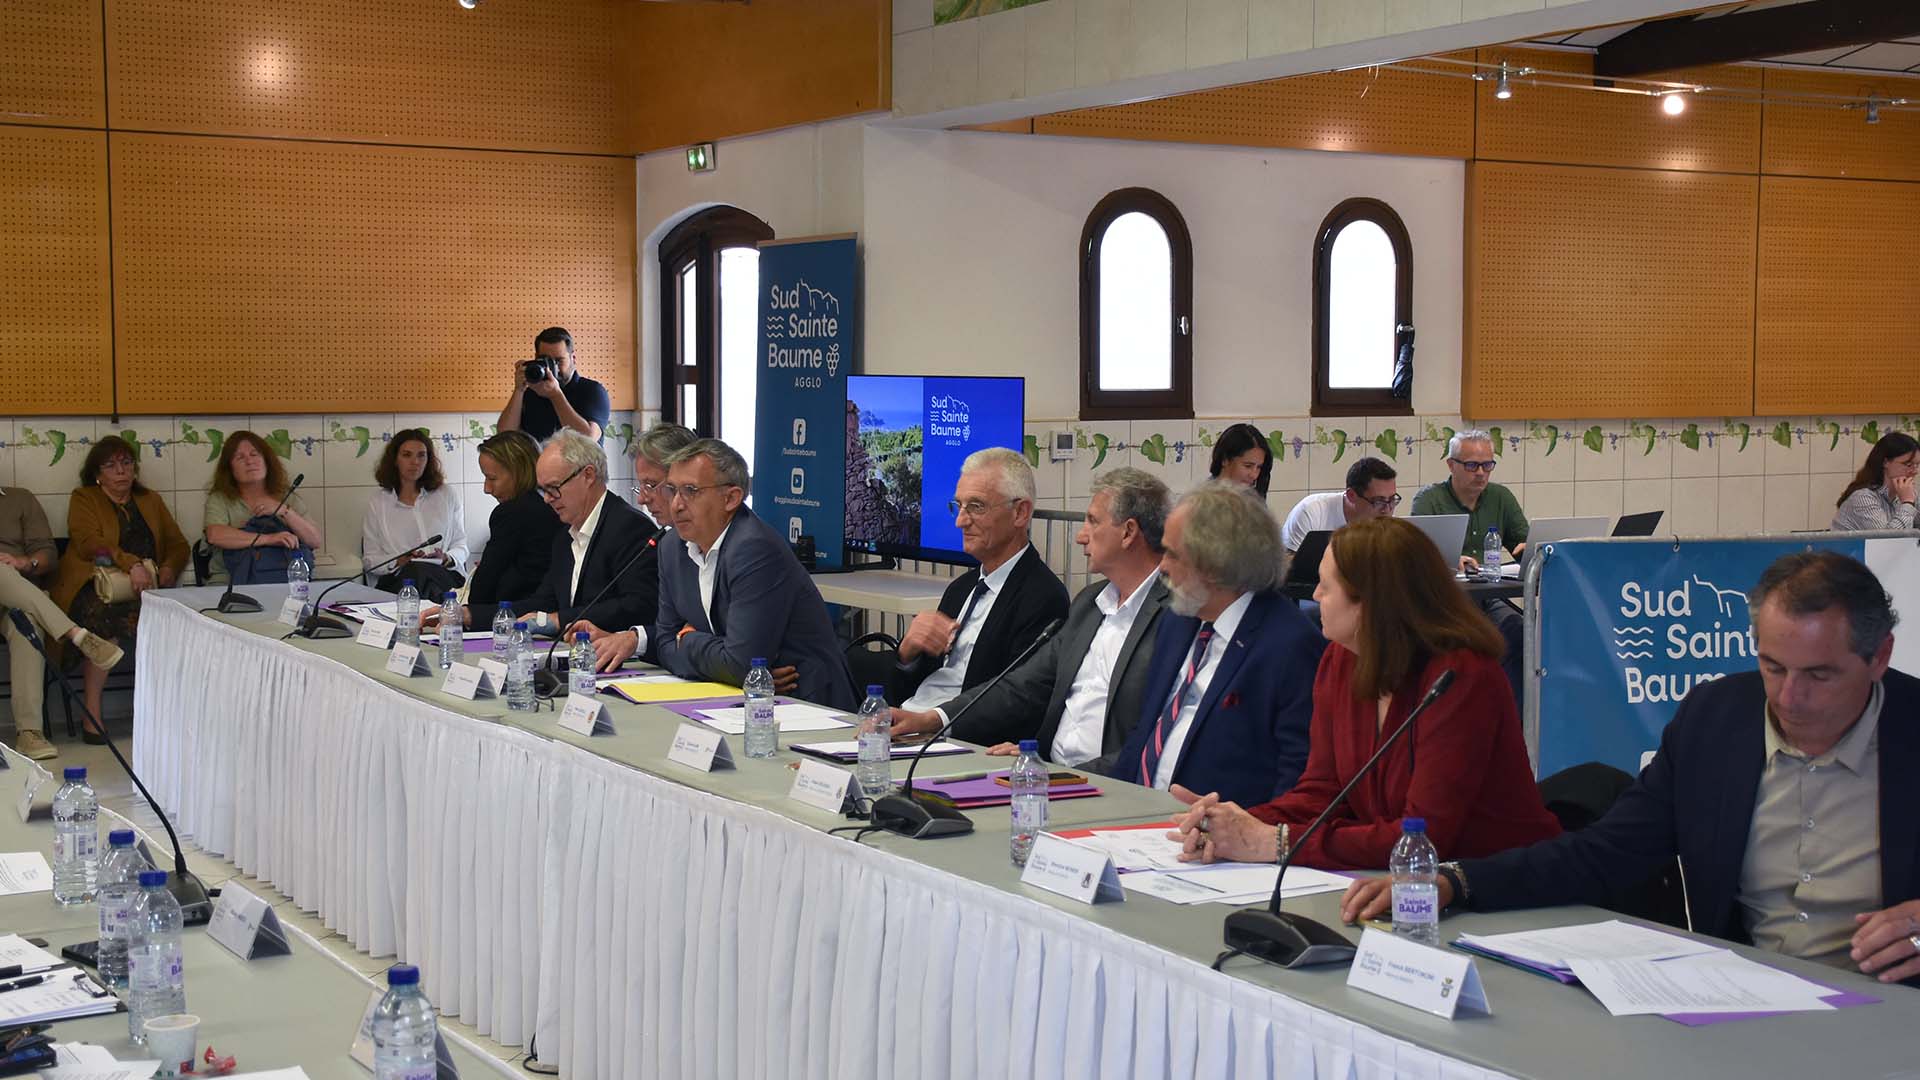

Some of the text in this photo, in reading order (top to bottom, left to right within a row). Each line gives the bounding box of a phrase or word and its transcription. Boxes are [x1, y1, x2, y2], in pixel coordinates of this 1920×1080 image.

[770, 282, 800, 309] Sud
[788, 311, 838, 338] Sainte
[768, 343, 823, 368] Baume
[794, 376, 822, 389] AGGLO
[931, 395, 948, 409] Sud
[941, 409, 969, 423] Sainte
[930, 423, 961, 437] Baume
[1620, 580, 1692, 618] Sud
[1665, 621, 1759, 660] Saint
[1624, 667, 1728, 704] Bau
[1399, 903, 1433, 914] BAUME
